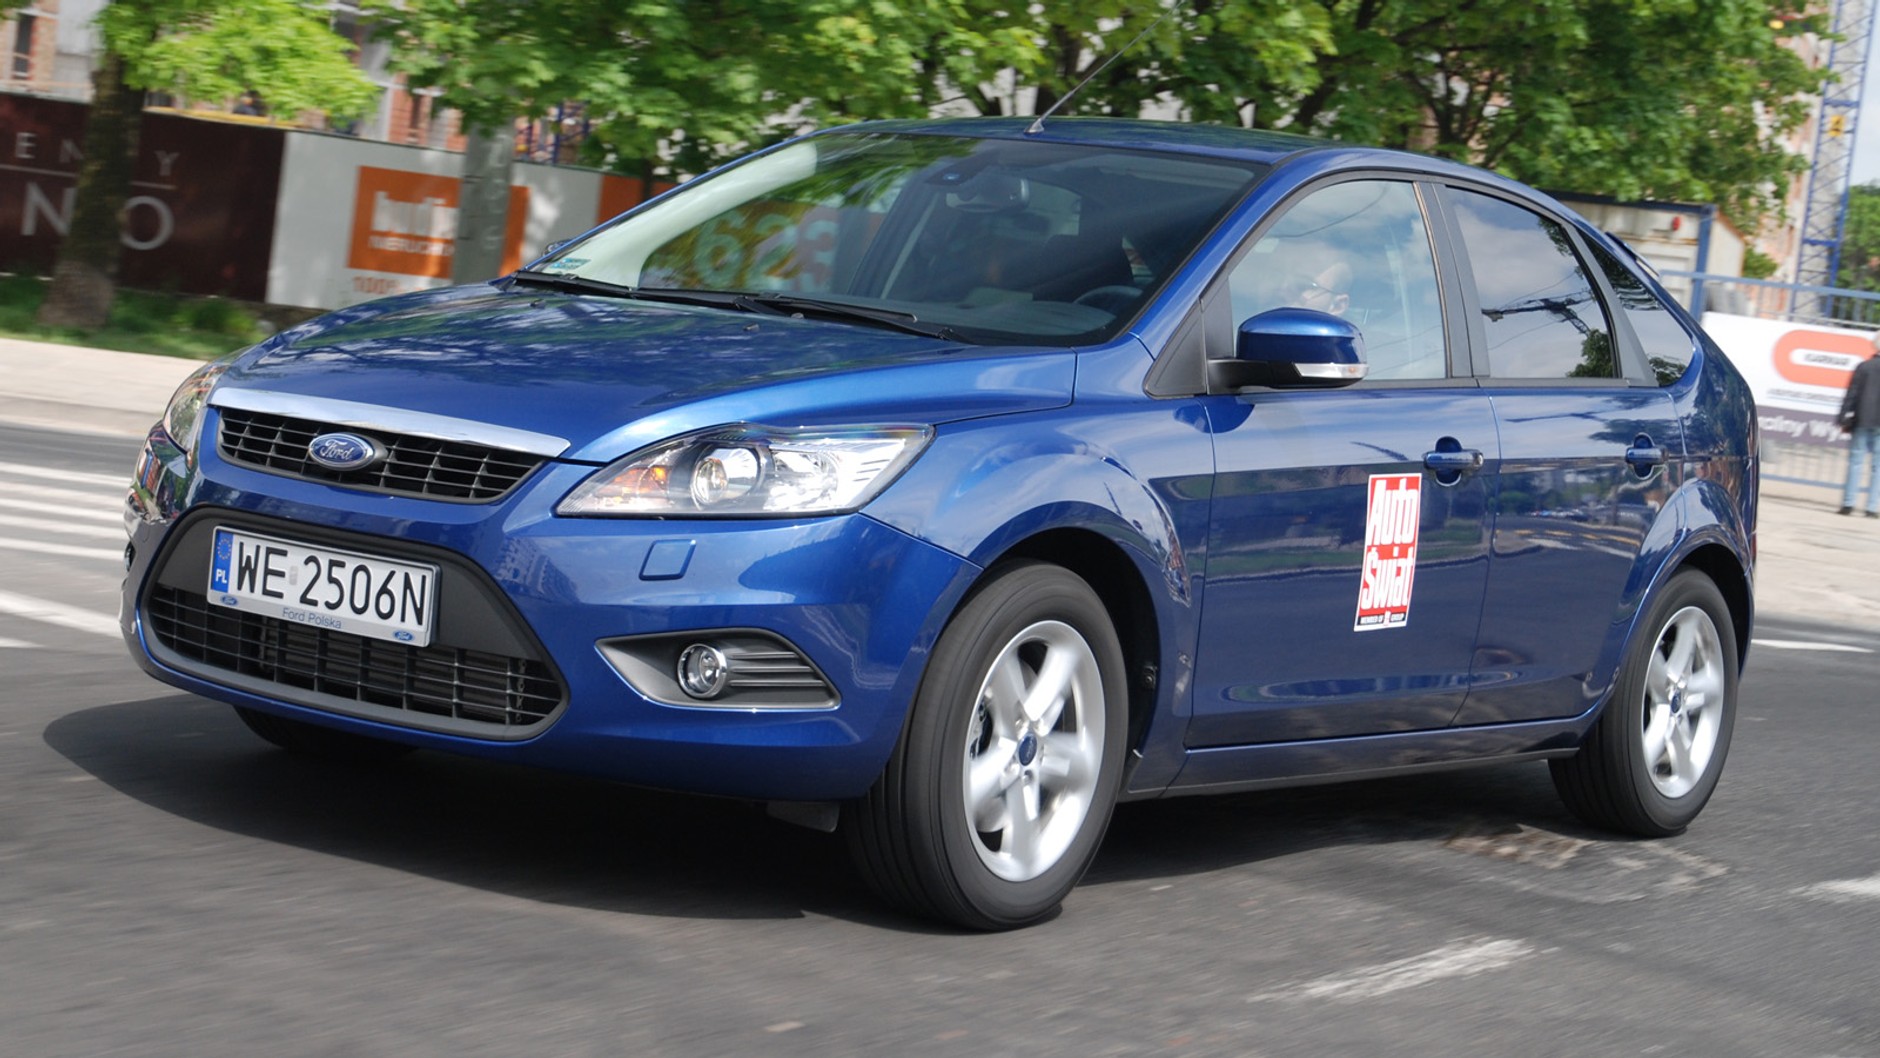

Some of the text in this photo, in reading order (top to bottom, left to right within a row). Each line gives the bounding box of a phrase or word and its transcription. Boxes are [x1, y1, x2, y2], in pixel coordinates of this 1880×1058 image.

[320, 438, 354, 459] Ford
[1367, 478, 1419, 546] Auto
[215, 569, 228, 584] PL
[237, 541, 427, 626] WE 2506N
[1361, 546, 1414, 610] Świat
[282, 607, 342, 630] Ford Polska
